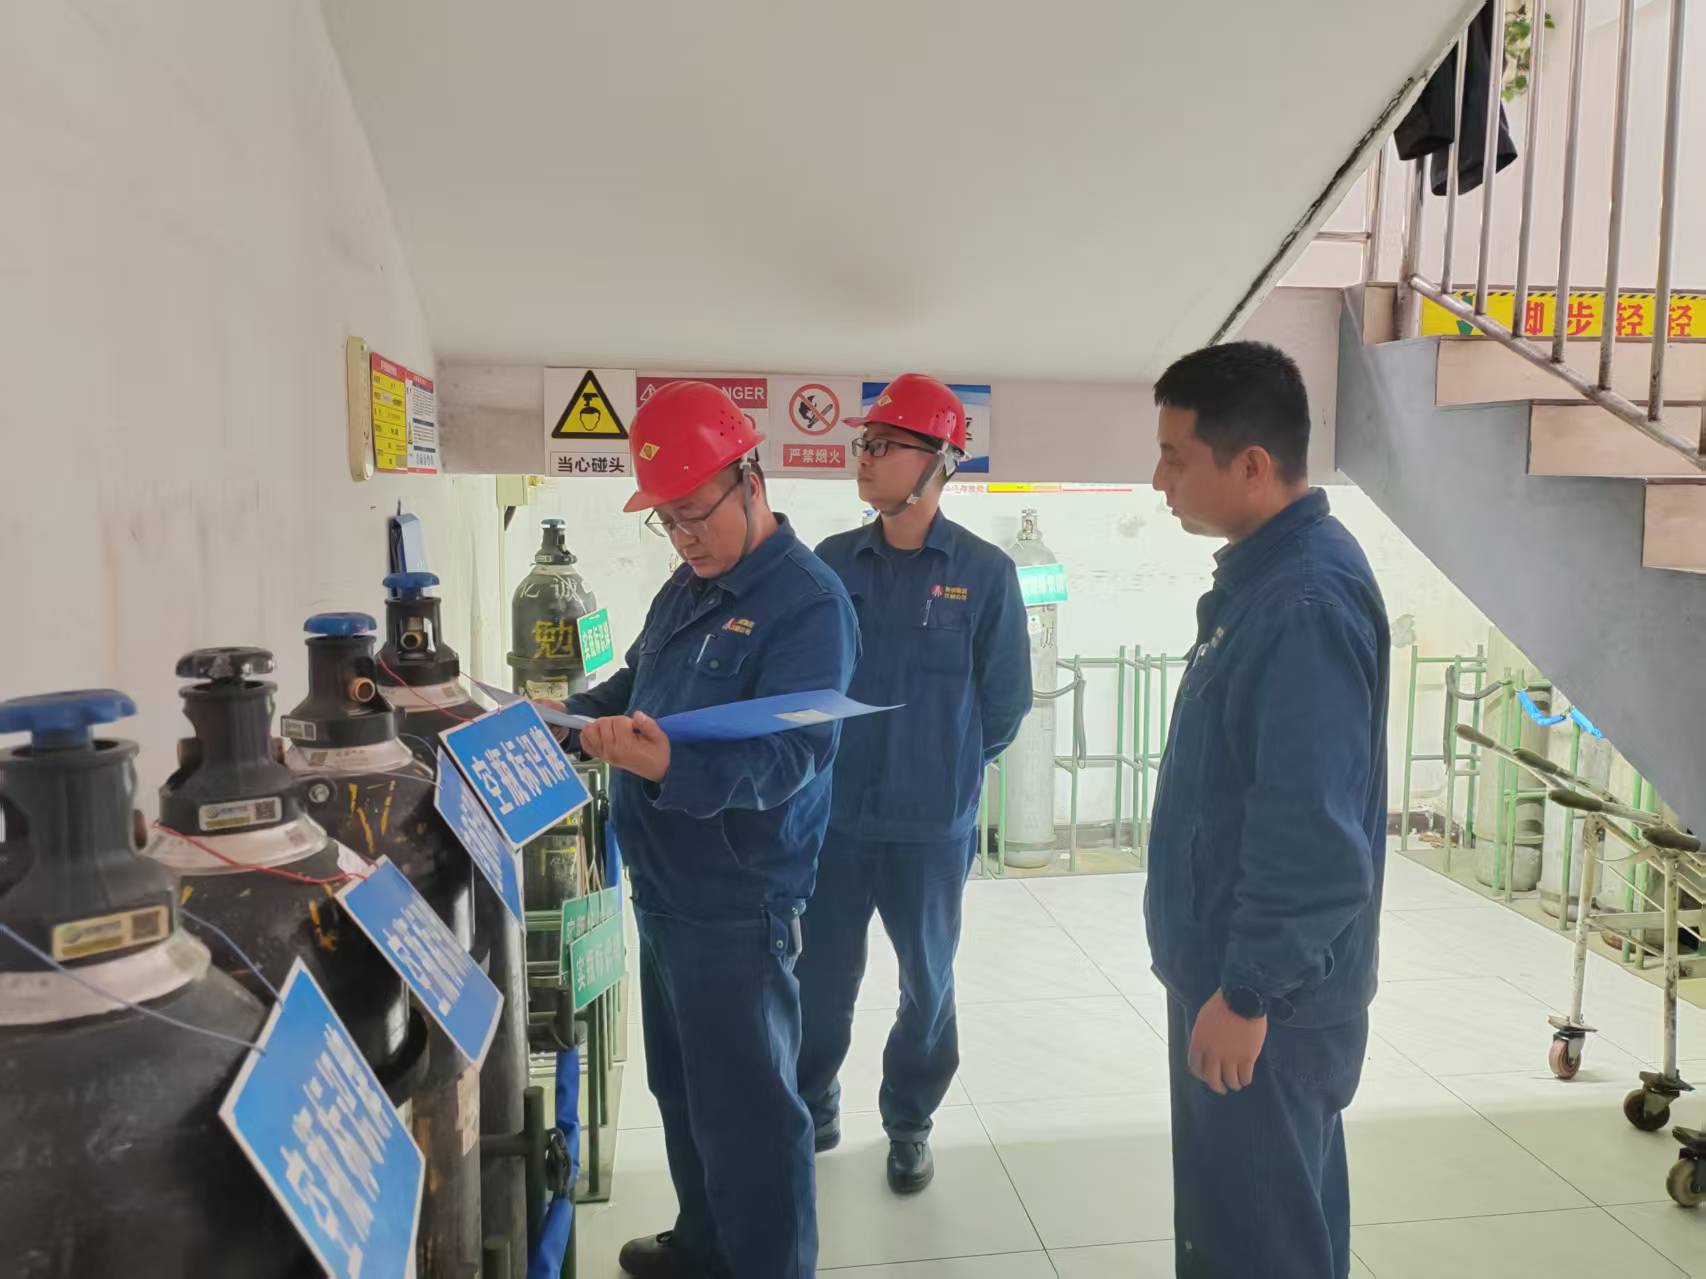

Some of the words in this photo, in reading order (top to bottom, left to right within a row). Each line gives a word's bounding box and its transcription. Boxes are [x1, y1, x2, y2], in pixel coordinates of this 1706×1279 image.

[721, 386, 766, 400] NGER
[788, 447, 841, 464] 严禁烟火
[558, 456, 625, 473] 当心碰头
[471, 724, 570, 816] 空瓶标识牌
